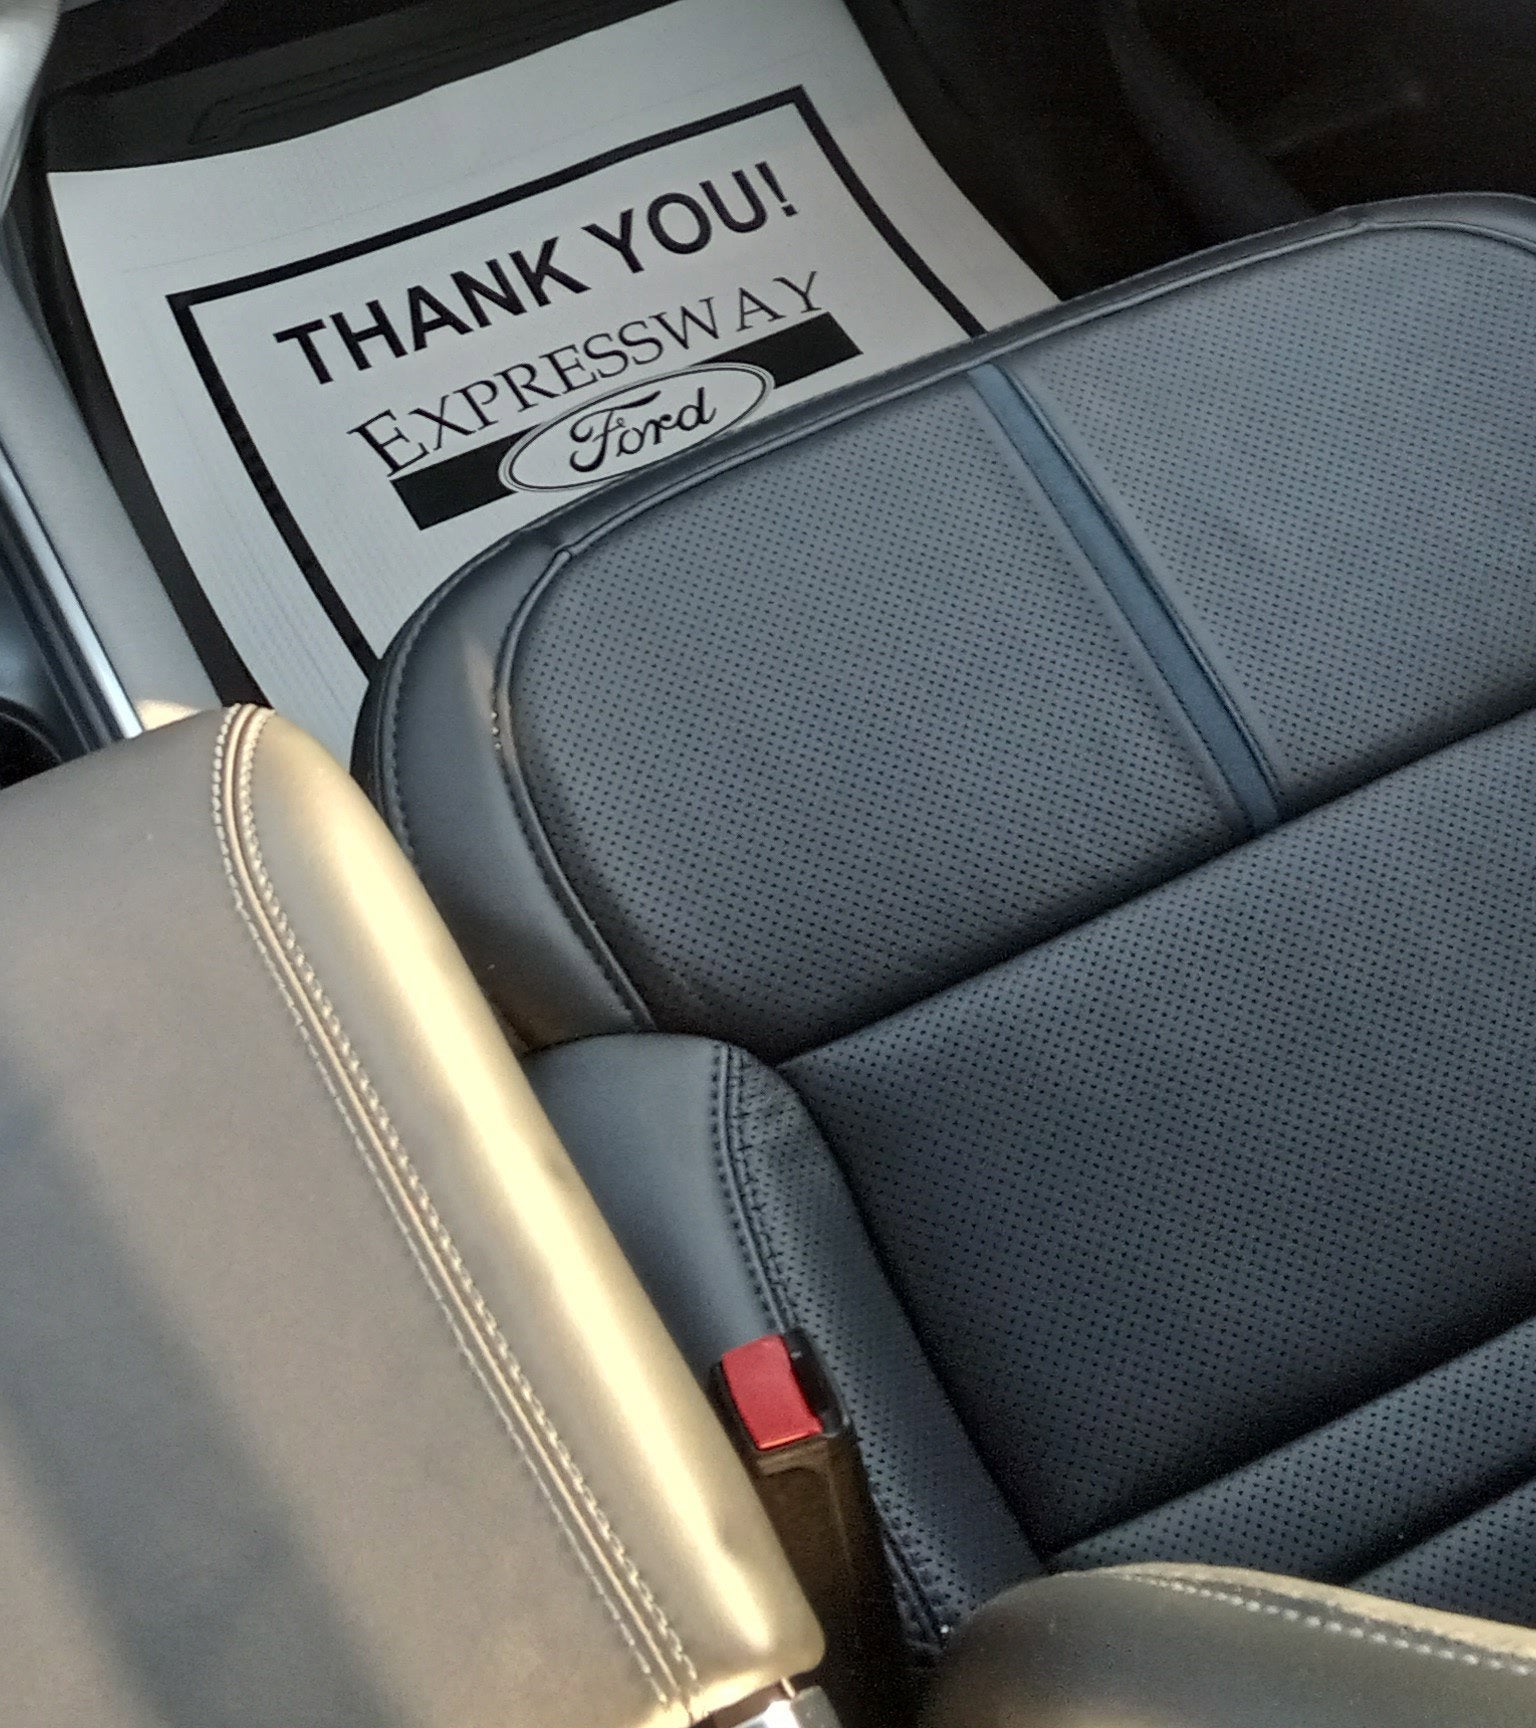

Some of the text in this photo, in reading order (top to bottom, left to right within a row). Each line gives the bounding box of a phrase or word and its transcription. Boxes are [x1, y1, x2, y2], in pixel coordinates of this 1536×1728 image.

[274, 161, 800, 386] THANK YOU!
[348, 270, 826, 479] EXPRESSWAY
[567, 386, 717, 476] Ford
